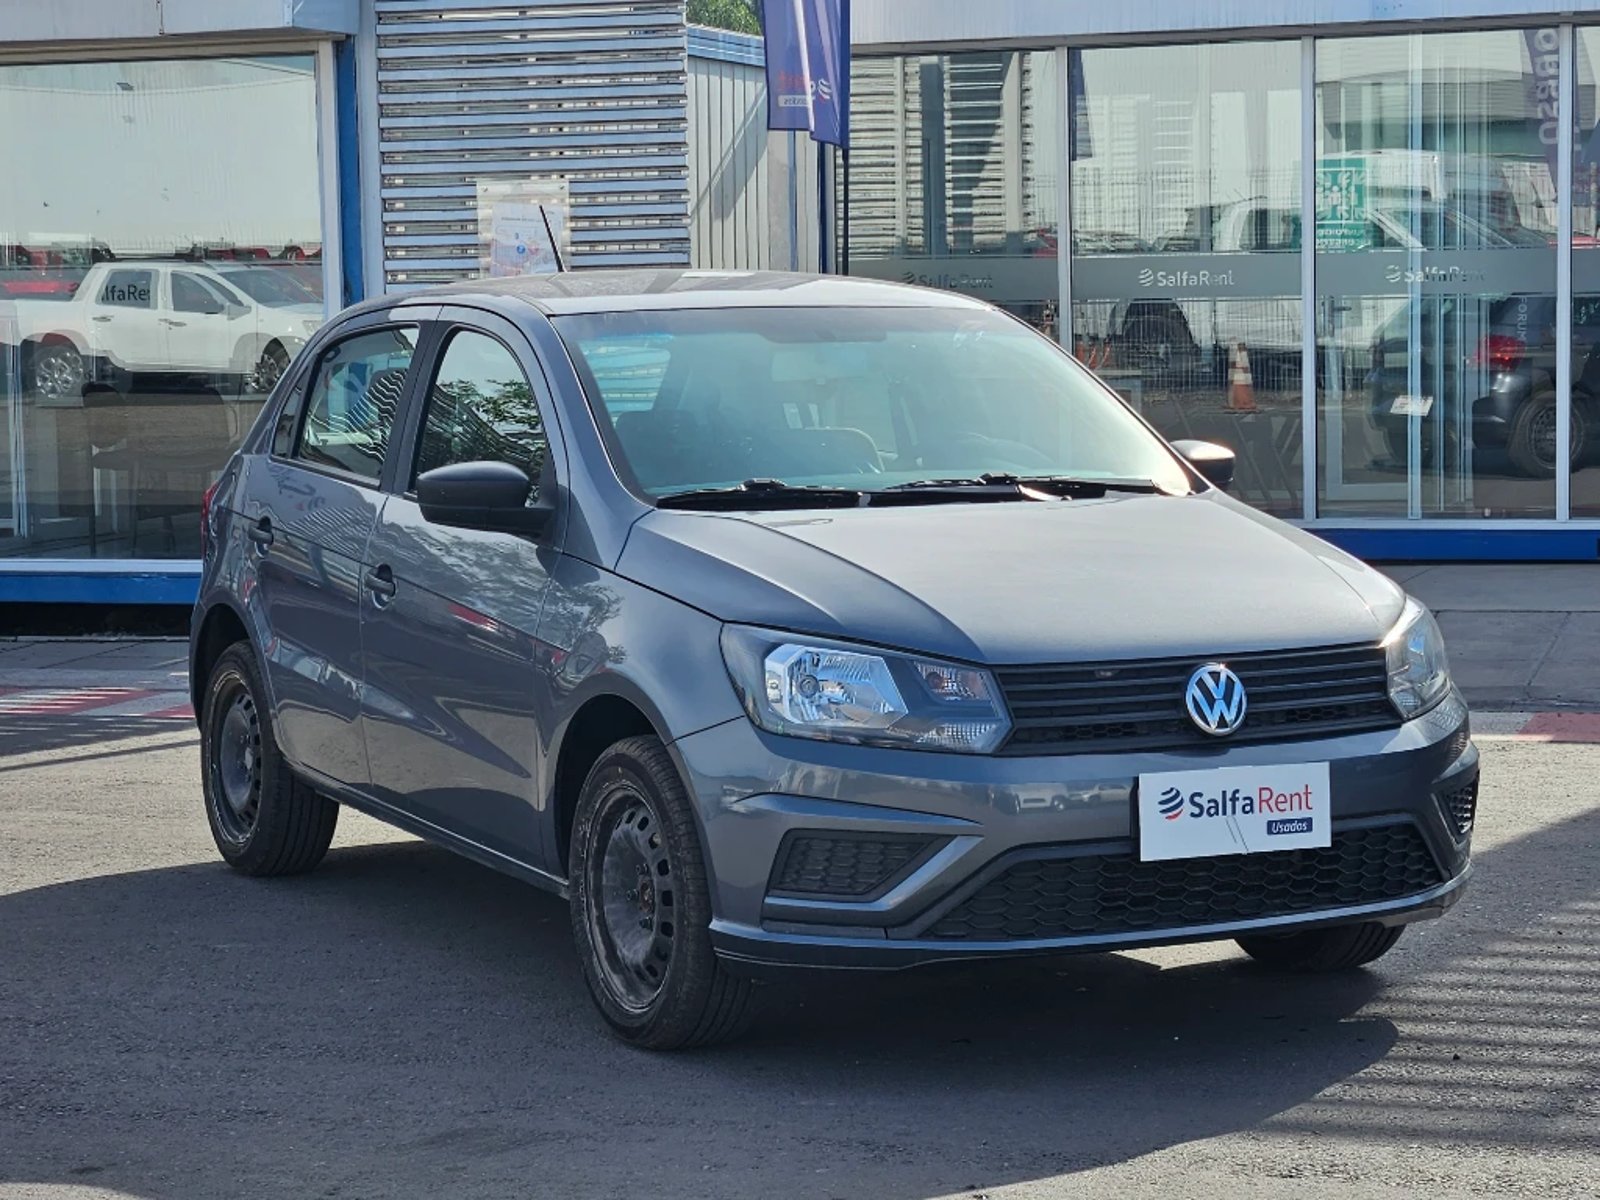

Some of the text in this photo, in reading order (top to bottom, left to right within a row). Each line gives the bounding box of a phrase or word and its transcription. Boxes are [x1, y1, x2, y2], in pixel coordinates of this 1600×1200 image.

[1157, 270, 1235, 286] SalfaRent
[102, 284, 150, 301] lfaRe
[1271, 821, 1308, 834] Usados
